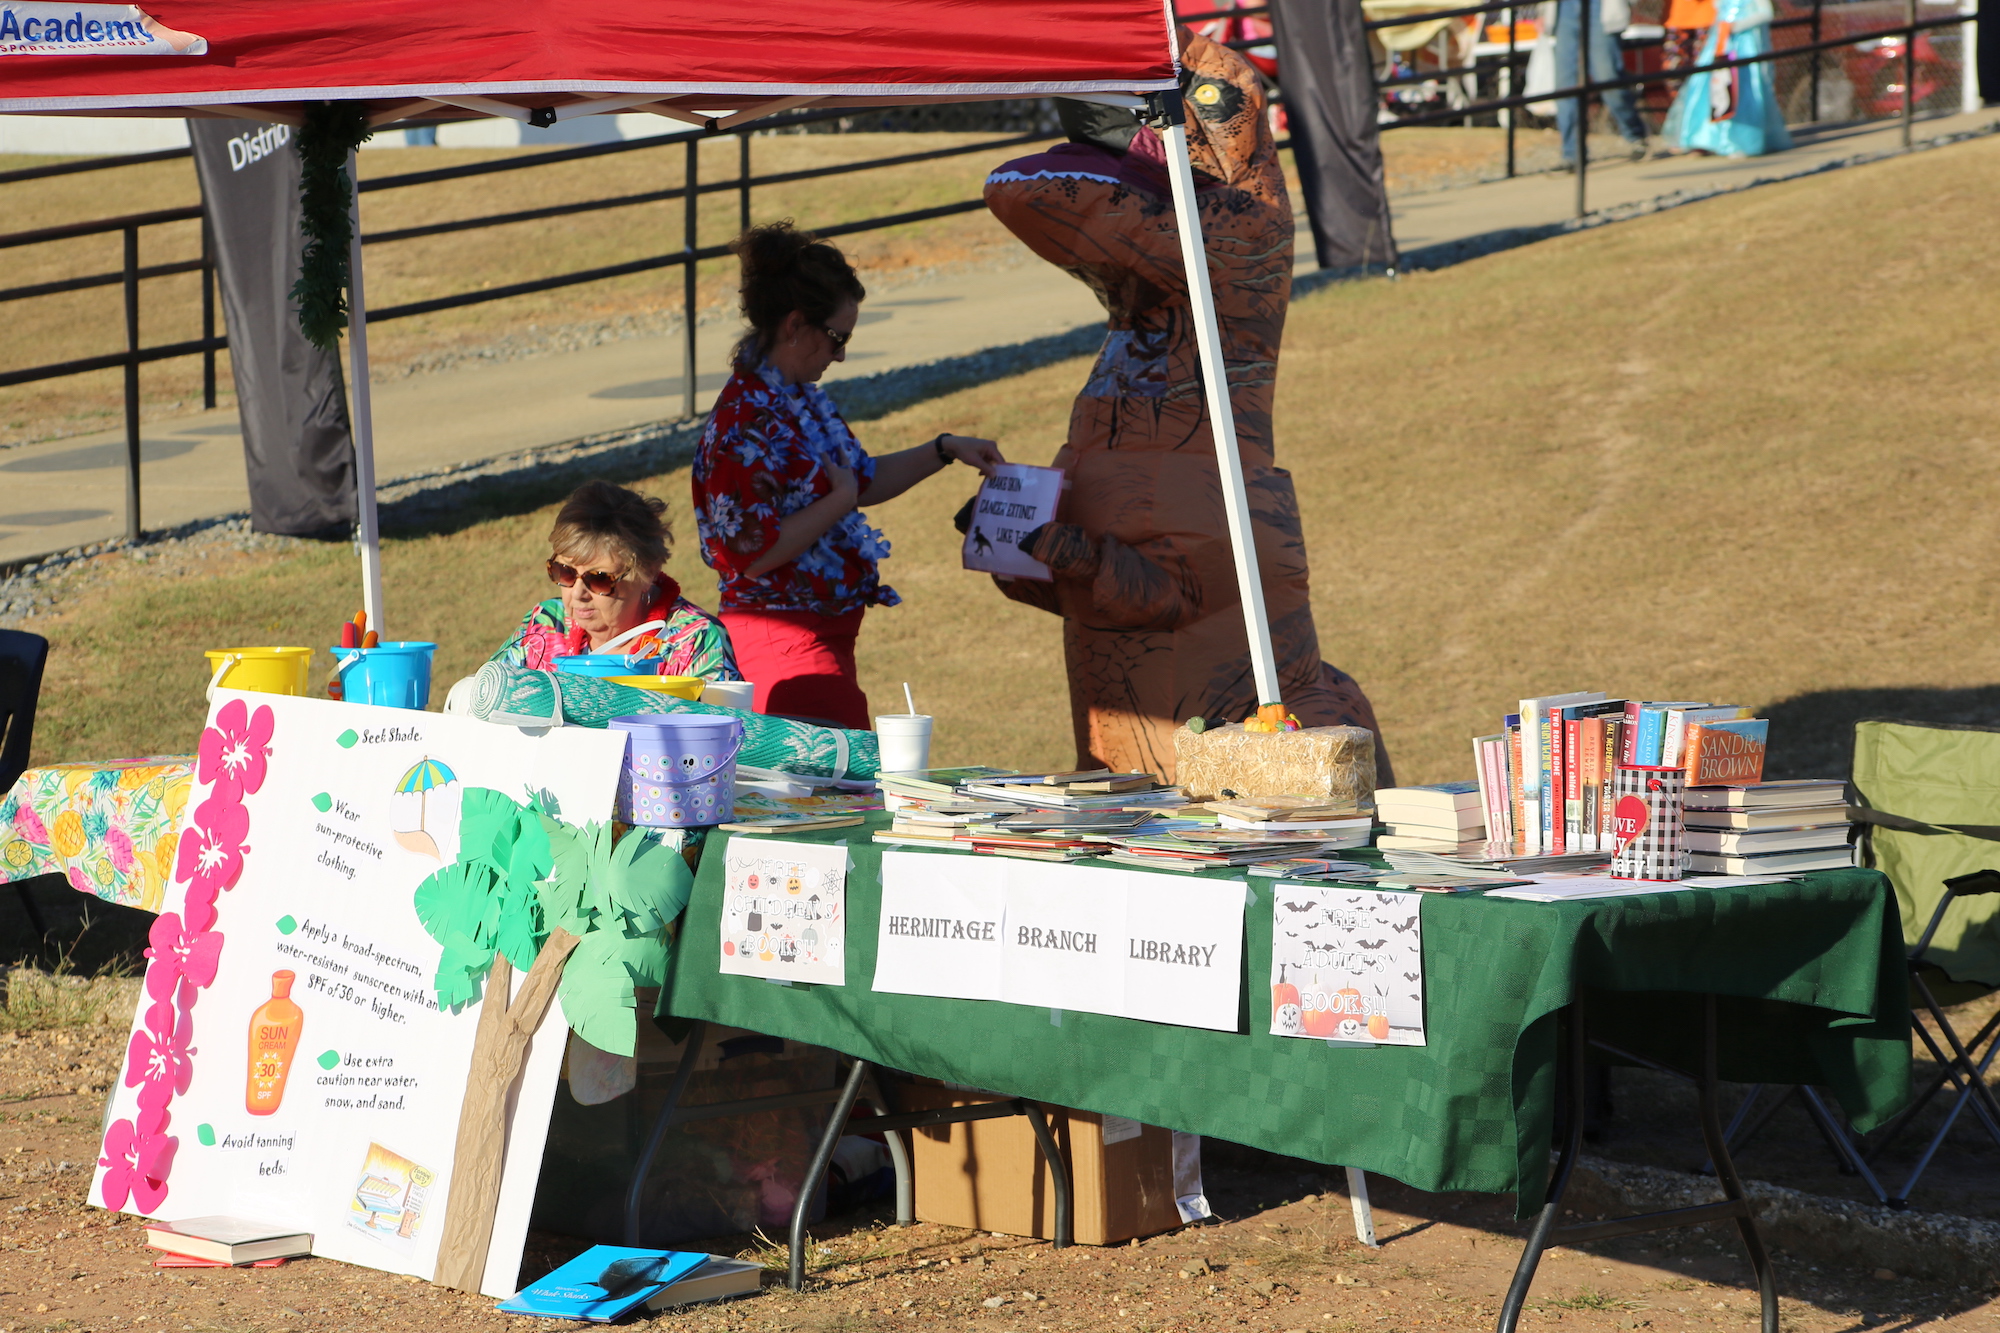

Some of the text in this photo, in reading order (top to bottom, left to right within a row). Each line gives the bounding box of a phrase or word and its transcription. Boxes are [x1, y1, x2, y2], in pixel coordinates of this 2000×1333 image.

[0, 10, 155, 42] Academy
[979, 499, 1037, 520] CANCER EXTINCT
[996, 527, 1013, 544] LIKE
[362, 726, 423, 744] Seek Shade.
[1606, 723, 1614, 736] VAL
[1552, 729, 1560, 752] ROADS
[1644, 734, 1653, 765] KARON
[1700, 733, 1763, 758] SANDRA
[1699, 755, 1758, 780] BROWN
[1517, 776, 1525, 807] CREED
[1568, 771, 1576, 799] children
[335, 799, 361, 823] Wear
[315, 822, 383, 860] sun-protective
[317, 850, 356, 880] clothing.
[763, 859, 807, 879] FREE
[1320, 908, 1371, 929] FREE
[302, 918, 422, 979] Apply a broad-spectrum,
[888, 915, 1217, 968] HERMITAGE BRANCH LIBRARY
[276, 941, 438, 1011] water-resistant sunscreen with an
[307, 973, 407, 1025] SPF of 30 or higher.
[260, 1026, 289, 1040] SUN
[258, 1041, 286, 1050] CREAM
[260, 1063, 276, 1078] 30
[343, 1052, 393, 1068] Use extra
[316, 1073, 418, 1088] caution near water,
[257, 1091, 272, 1100] SPF
[324, 1094, 405, 1110] snow, and sand.
[222, 1133, 293, 1151] Avoid tanning
[259, 1159, 286, 1177] beds.
